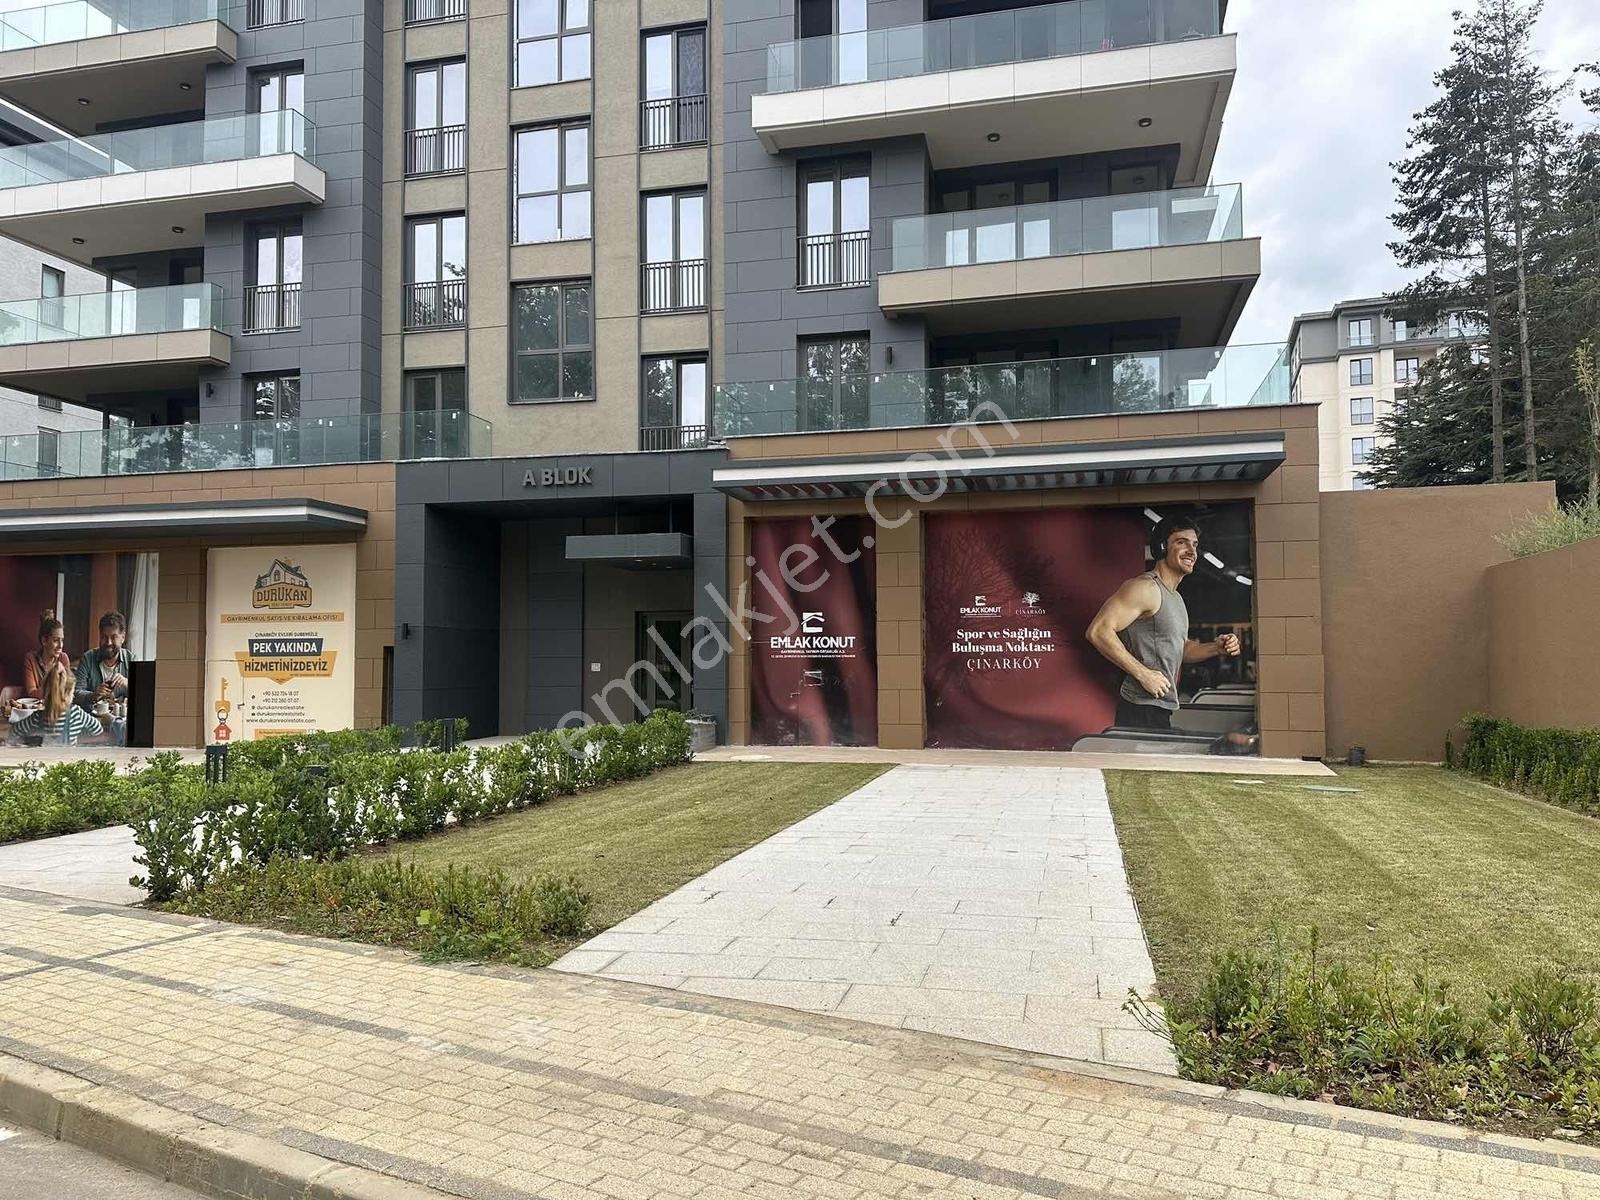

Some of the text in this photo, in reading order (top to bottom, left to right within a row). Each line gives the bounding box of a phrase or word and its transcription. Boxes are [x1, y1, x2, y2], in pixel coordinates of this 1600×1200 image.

[522, 467, 592, 486] A BLOK
[256, 587, 308, 602] DURUKAN
[957, 628, 1051, 641] Spor ve Sağlığın
[253, 642, 318, 653] PEK YAKINDA
[770, 636, 856, 648] EMLAK KONUT
[952, 642, 1055, 655] Buluşma Noktası:
[244, 658, 328, 671] HİZMETİNİZDEYİZ
[967, 657, 1041, 671] ÇINARKÖY
